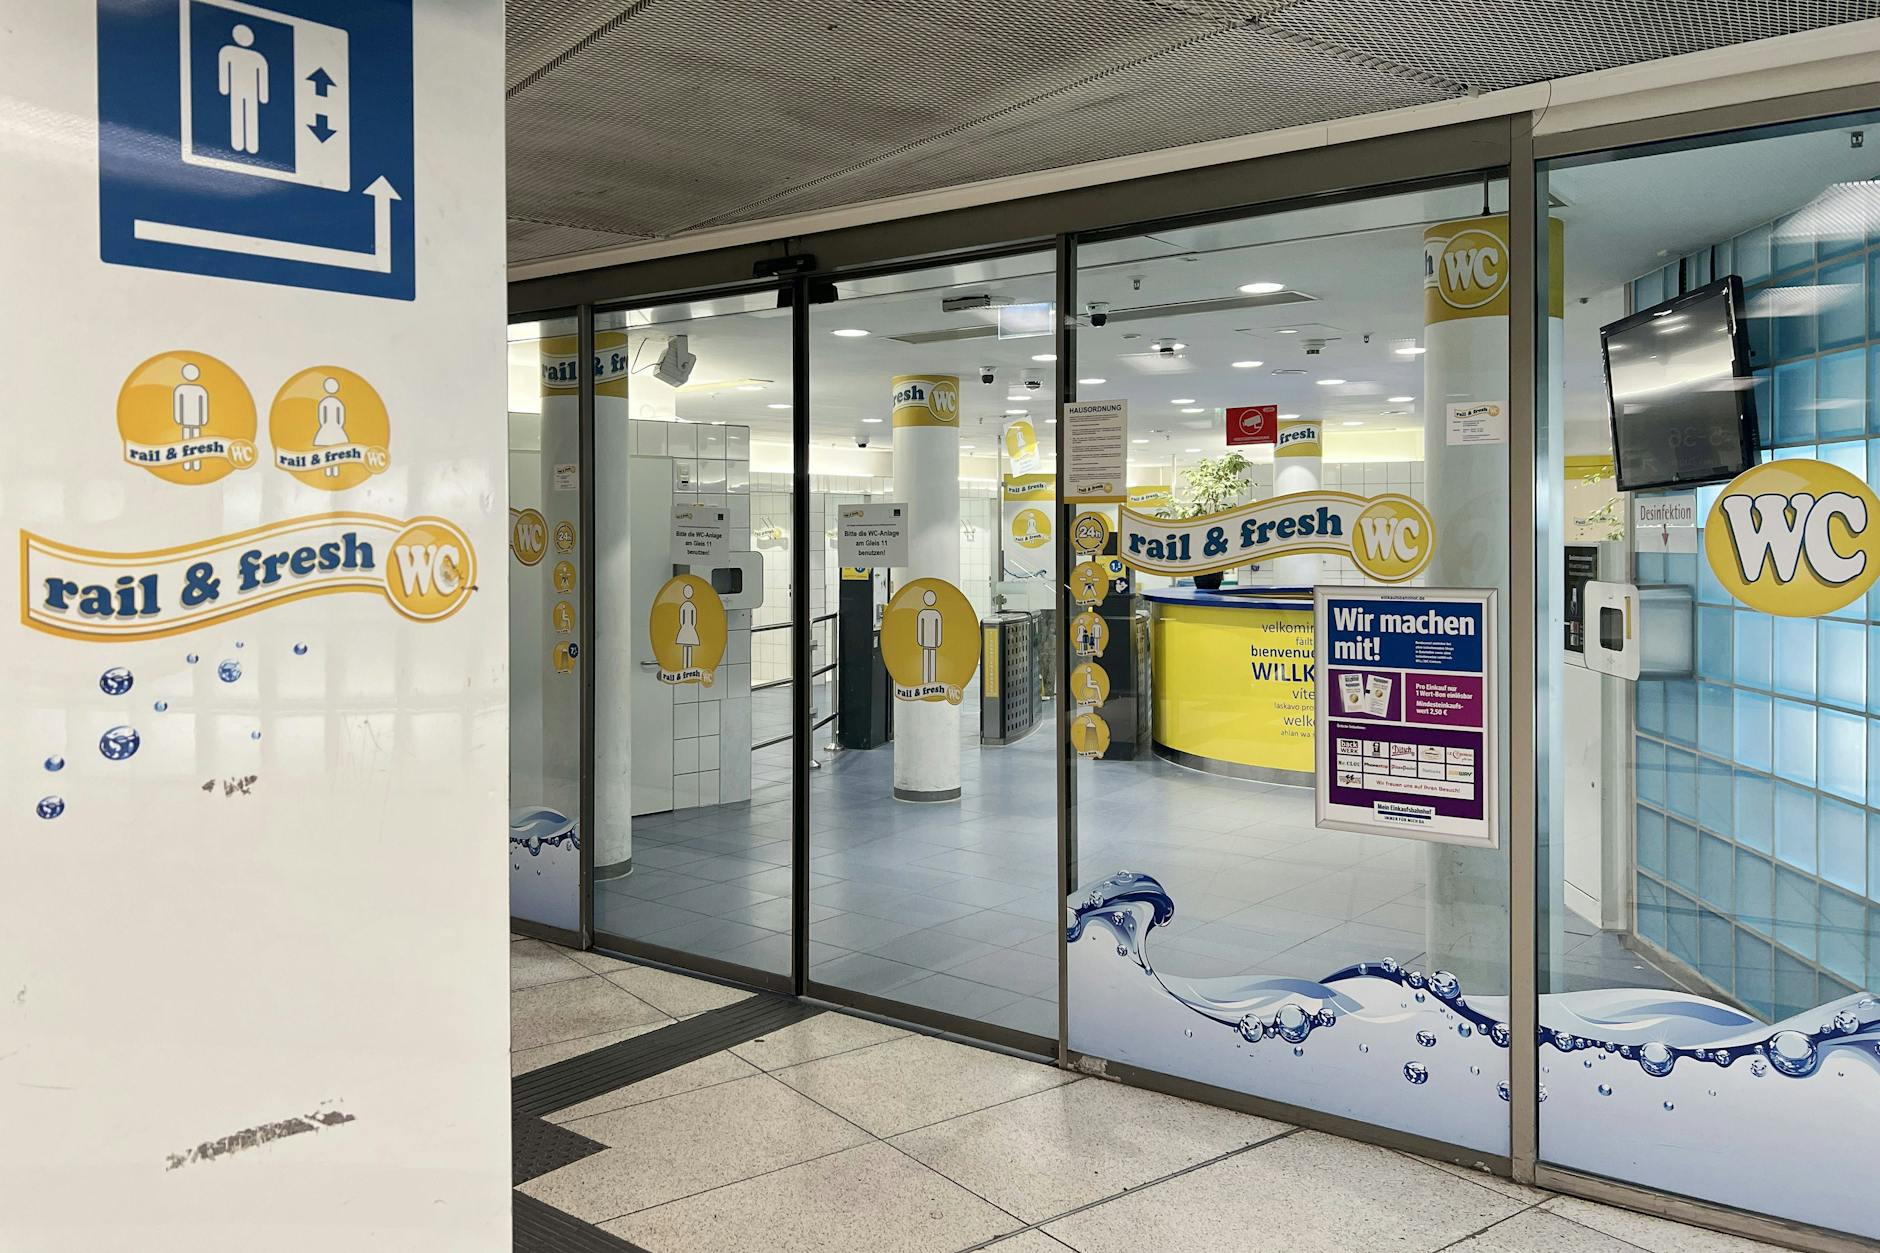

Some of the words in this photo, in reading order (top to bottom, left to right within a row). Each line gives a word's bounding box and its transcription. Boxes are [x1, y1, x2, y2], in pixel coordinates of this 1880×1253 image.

[1443, 247, 1498, 292] WC
[542, 361, 577, 381] rail
[932, 390, 956, 412] WC
[1069, 404, 1122, 414] HAUSORDNUNG
[1279, 427, 1315, 444] fresh
[130, 449, 161, 461] rail
[166, 448, 177, 460] &
[182, 441, 224, 457] fresh
[231, 445, 253, 463] WC
[280, 455, 306, 467] rail
[311, 454, 320, 465] &
[325, 448, 361, 462] fresh
[367, 451, 386, 467] WC
[1640, 504, 1692, 521] Desinfektion
[516, 524, 543, 553] WC
[696, 532, 722, 540] WC-Anlage
[868, 530, 900, 538] WC-Anlage
[1080, 526, 1102, 538] 24h
[1129, 532, 1192, 561] rail
[1203, 527, 1229, 557] &
[1240, 507, 1344, 548] fresh
[1359, 517, 1420, 562] WC
[1720, 491, 1868, 586] WC
[45, 574, 161, 618] rail
[181, 562, 220, 606] &
[239, 532, 374, 593] fresh
[396, 543, 463, 598] WC
[1333, 607, 1374, 632] Wir
[1380, 609, 1475, 636] machen
[1334, 635, 1381, 661] mit!
[663, 673, 675, 681] rail
[676, 673, 681, 681] &
[682, 670, 700, 678] fresh
[1252, 662, 1314, 682] WILLK
[897, 689, 912, 698] rail
[914, 689, 920, 697] &
[922, 685, 945, 695] fresh
[1416, 701, 1464, 709] Mindesteinkaufs-
[1391, 804, 1432, 815] Einkaufsbahnhof
